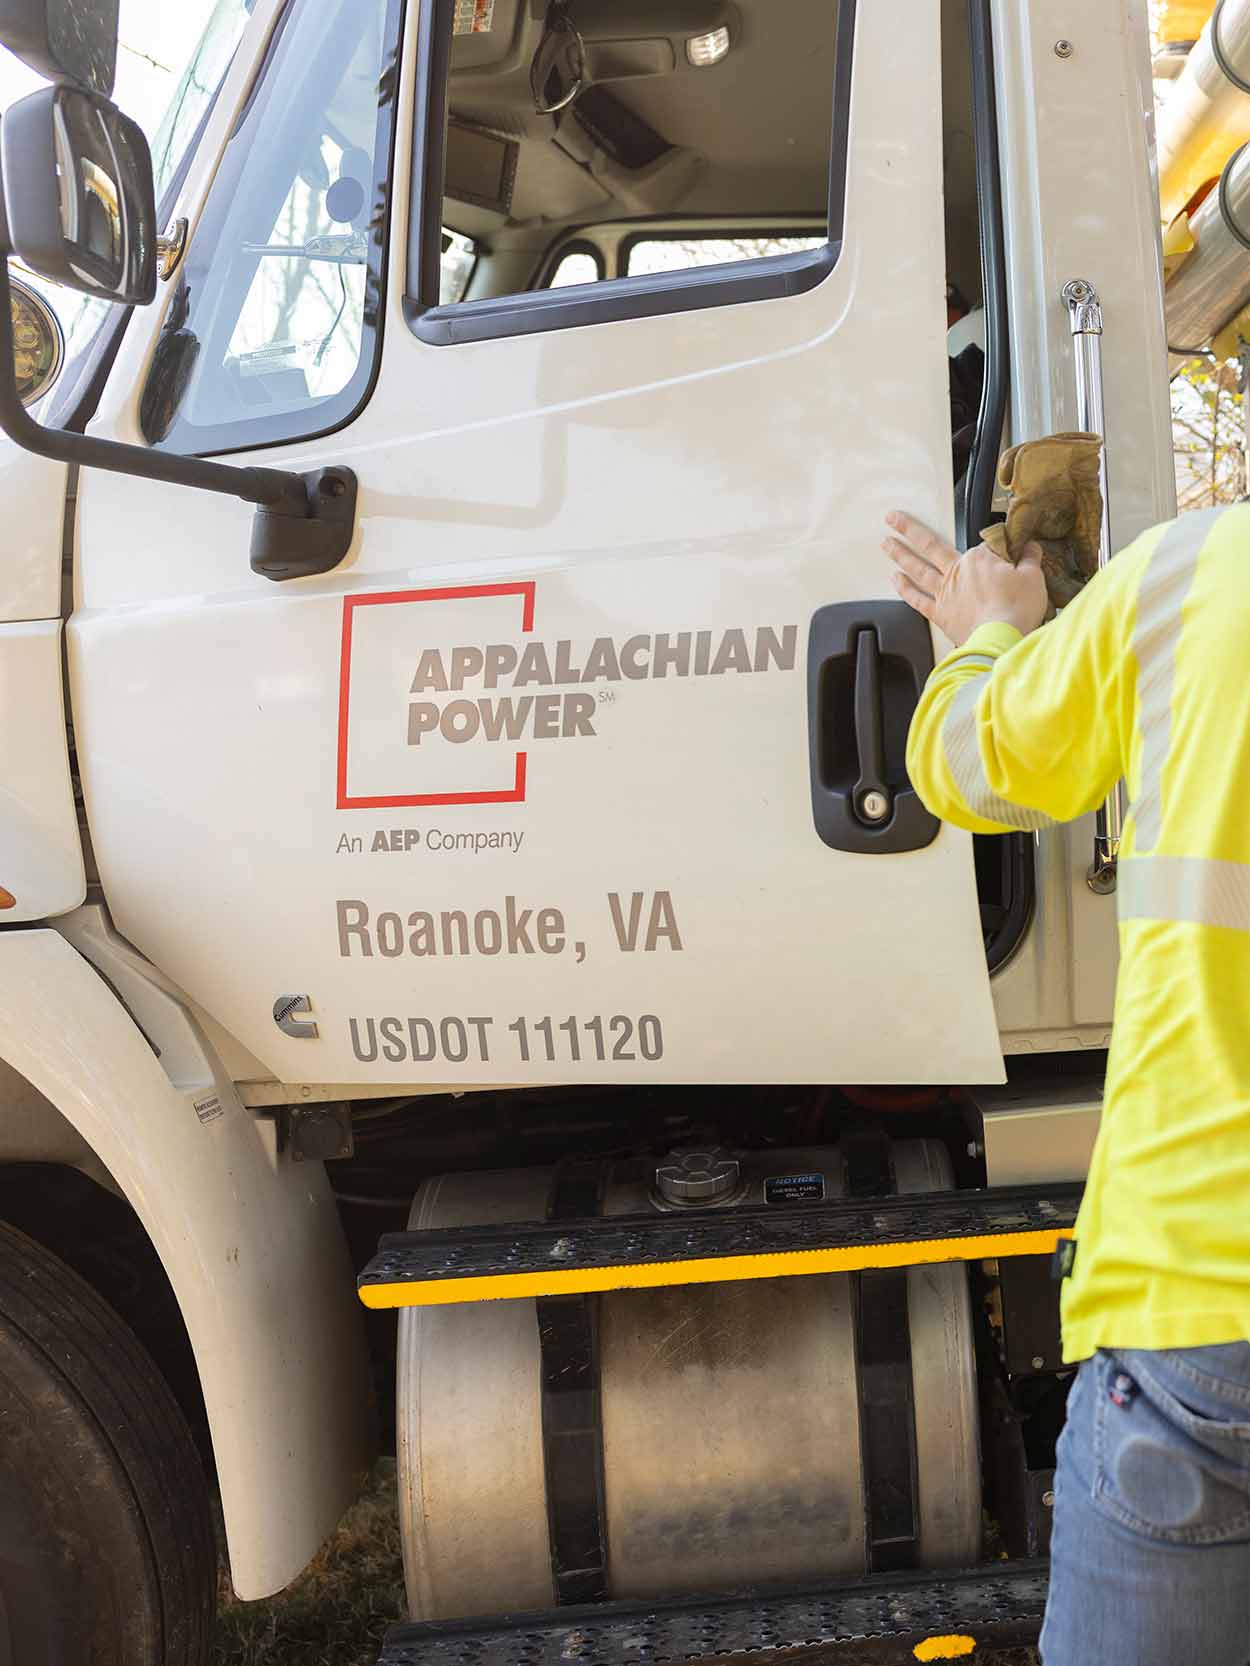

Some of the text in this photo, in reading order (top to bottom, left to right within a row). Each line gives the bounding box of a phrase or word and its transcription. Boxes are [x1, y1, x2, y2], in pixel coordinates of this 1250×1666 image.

[409, 624, 799, 693] APPALACHIAN
[407, 692, 598, 746] POWER
[336, 828, 525, 854] An AEP Company
[336, 890, 684, 963] Roanoke, VA
[273, 995, 304, 1022] Cummins
[349, 1013, 664, 1062] USDOT 111120
[775, 1175, 816, 1185] NOTICE
